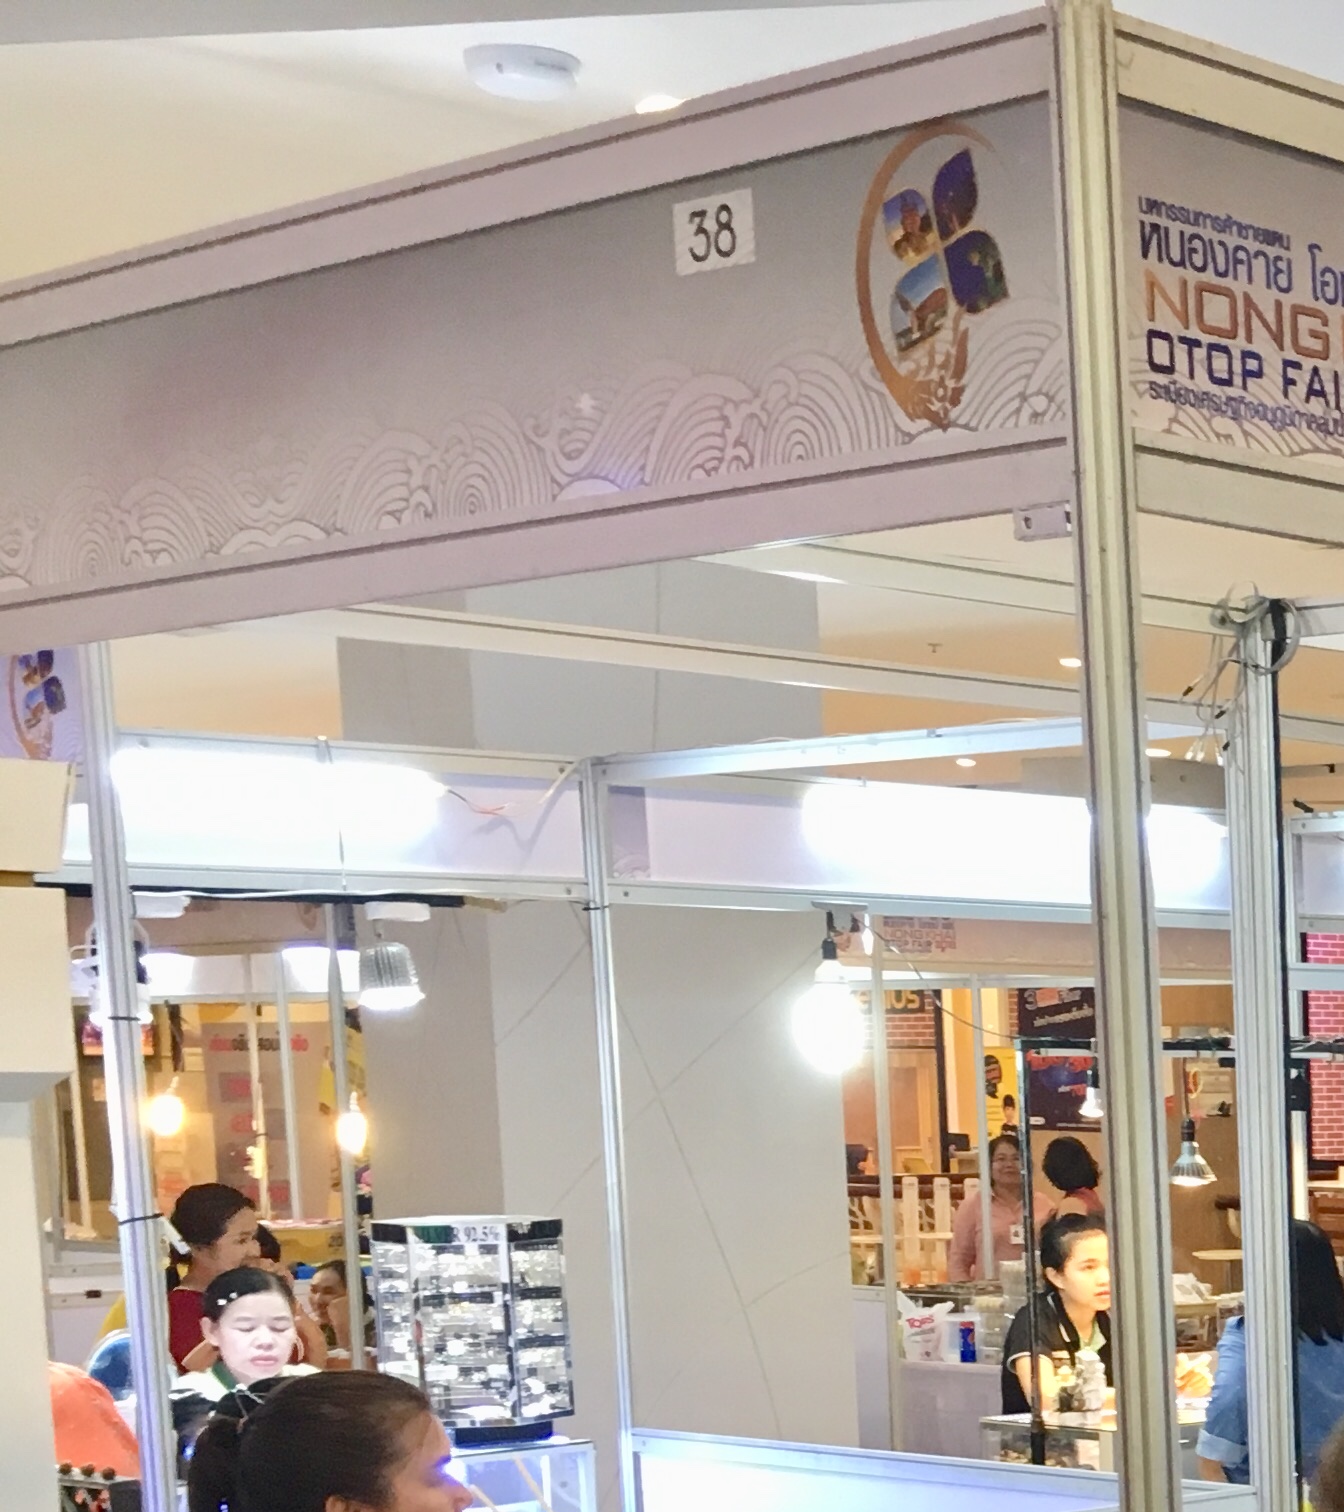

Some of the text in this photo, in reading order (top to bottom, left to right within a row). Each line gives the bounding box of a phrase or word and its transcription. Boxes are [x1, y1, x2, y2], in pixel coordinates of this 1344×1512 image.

[688, 203, 737, 263] 38
[1139, 220, 1293, 294] หนองคาย
[1144, 268, 1330, 361] NONG
[1146, 329, 1264, 391] OTOP
